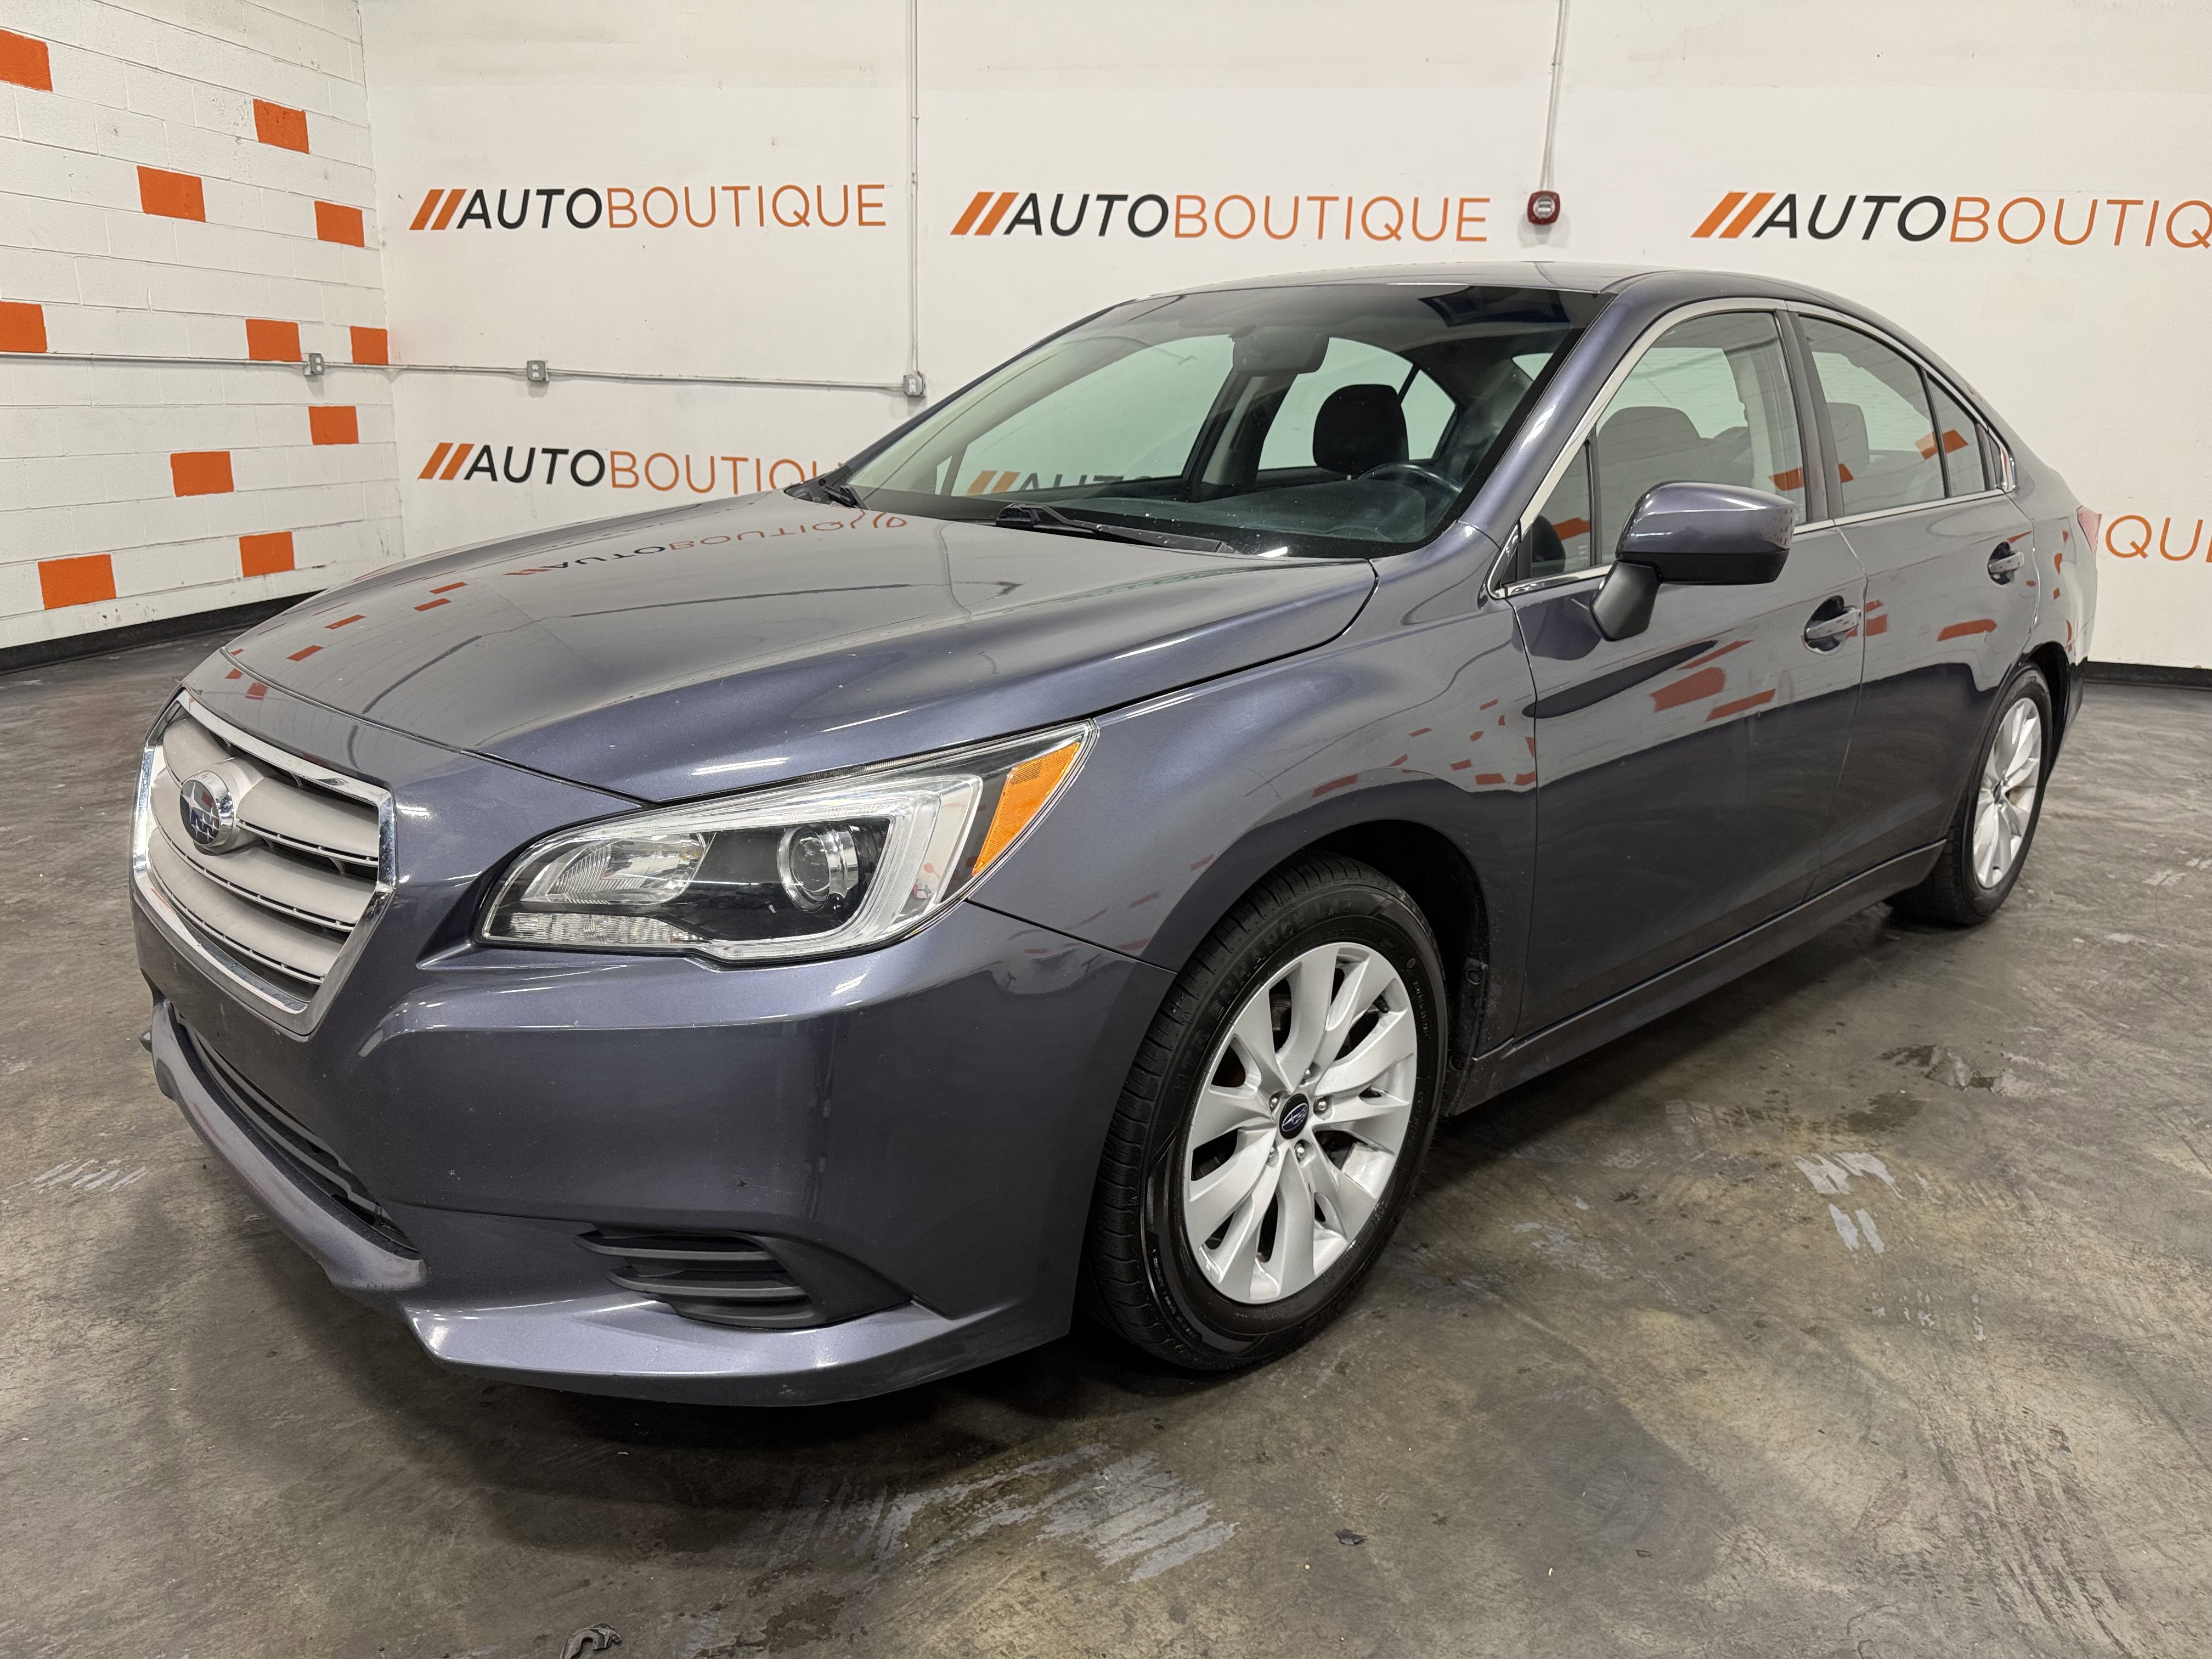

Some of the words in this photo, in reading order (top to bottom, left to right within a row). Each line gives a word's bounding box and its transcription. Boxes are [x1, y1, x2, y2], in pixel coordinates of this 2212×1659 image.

[457, 184, 886, 229] AUTOBOUTIQUE
[1004, 192, 1489, 241] AUTOBOUTIQUE
[1172, 1031, 1210, 1096] HTR
